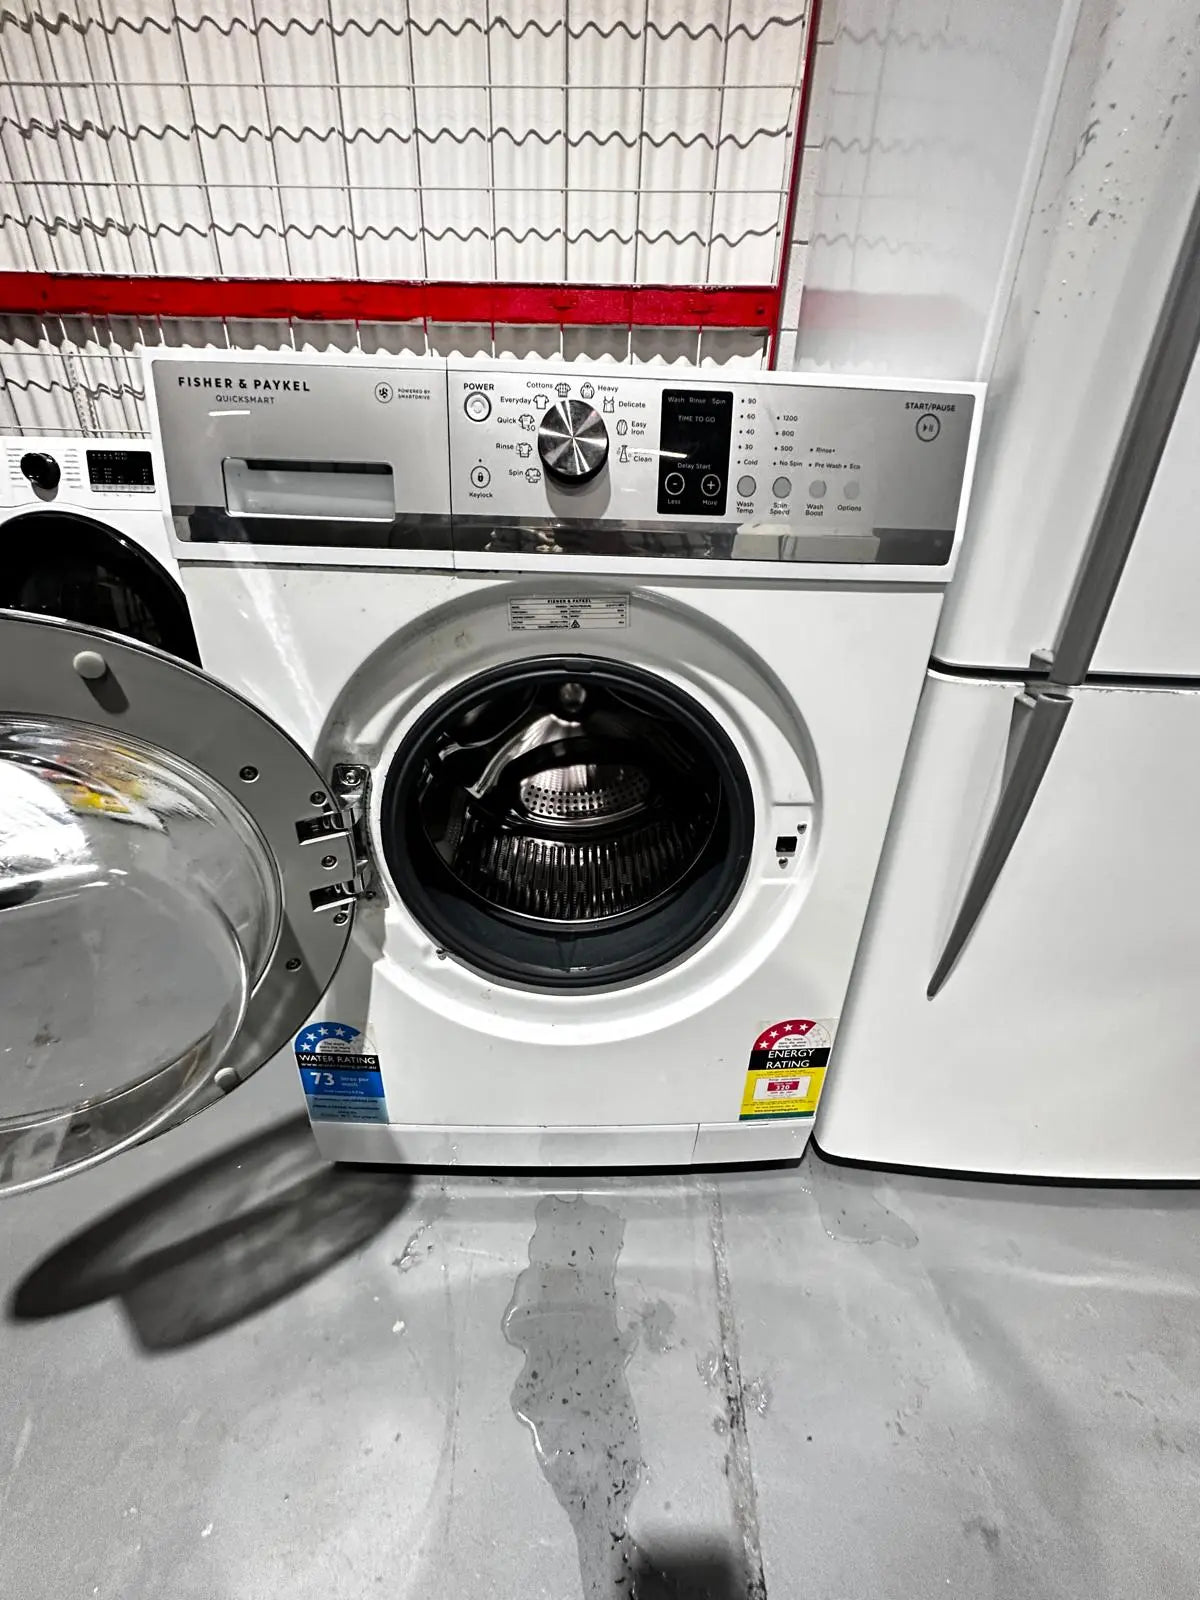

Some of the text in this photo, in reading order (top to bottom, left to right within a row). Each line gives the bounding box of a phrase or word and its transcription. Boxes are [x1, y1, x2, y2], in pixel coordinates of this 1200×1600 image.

[178, 376, 310, 392] FISHER & PAYKEL
[216, 394, 274, 404] QUICKSMART
[905, 402, 955, 412] START/PAUSE
[768, 1049, 815, 1058] ENERGY
[337, 1056, 375, 1064] RATING
[766, 1060, 810, 1069] RATING
[310, 1072, 335, 1085] 73
